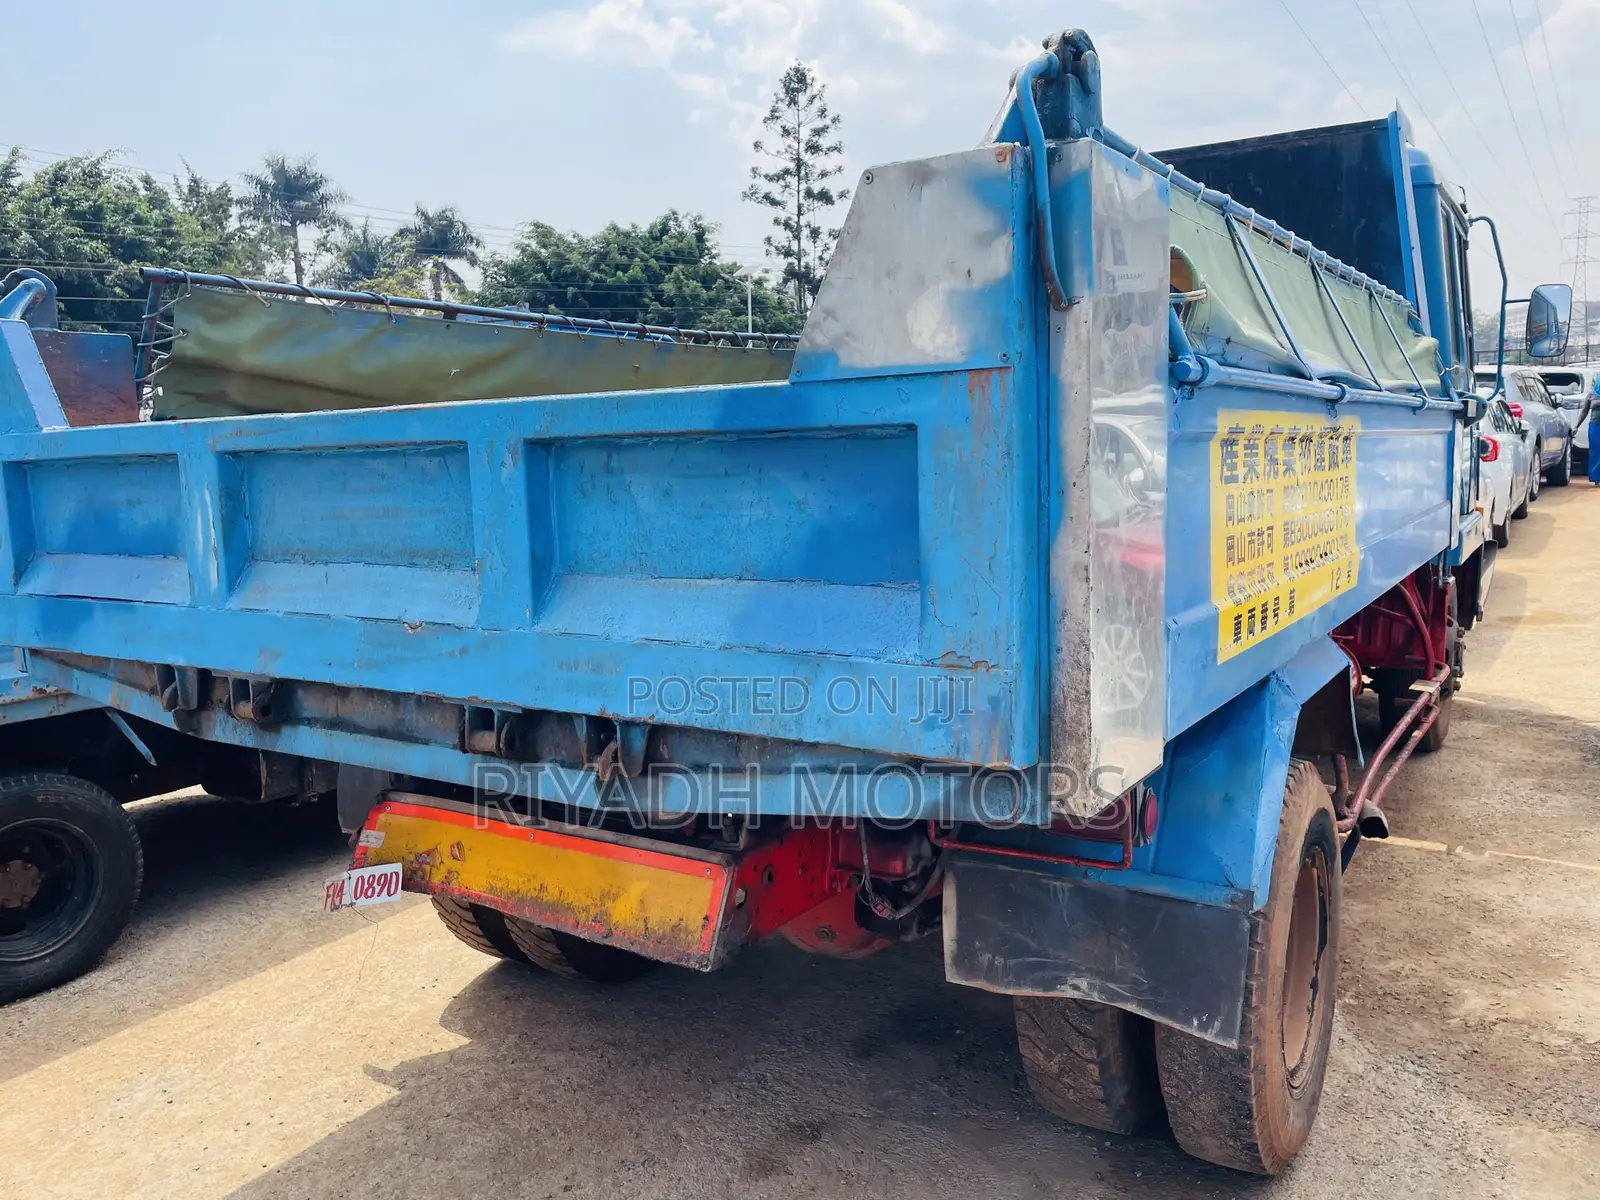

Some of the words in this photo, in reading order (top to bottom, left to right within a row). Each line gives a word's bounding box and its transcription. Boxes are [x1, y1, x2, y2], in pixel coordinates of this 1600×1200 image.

[1226, 525, 1274, 568] 岡山市許可
[353, 871, 400, 901] 0890
